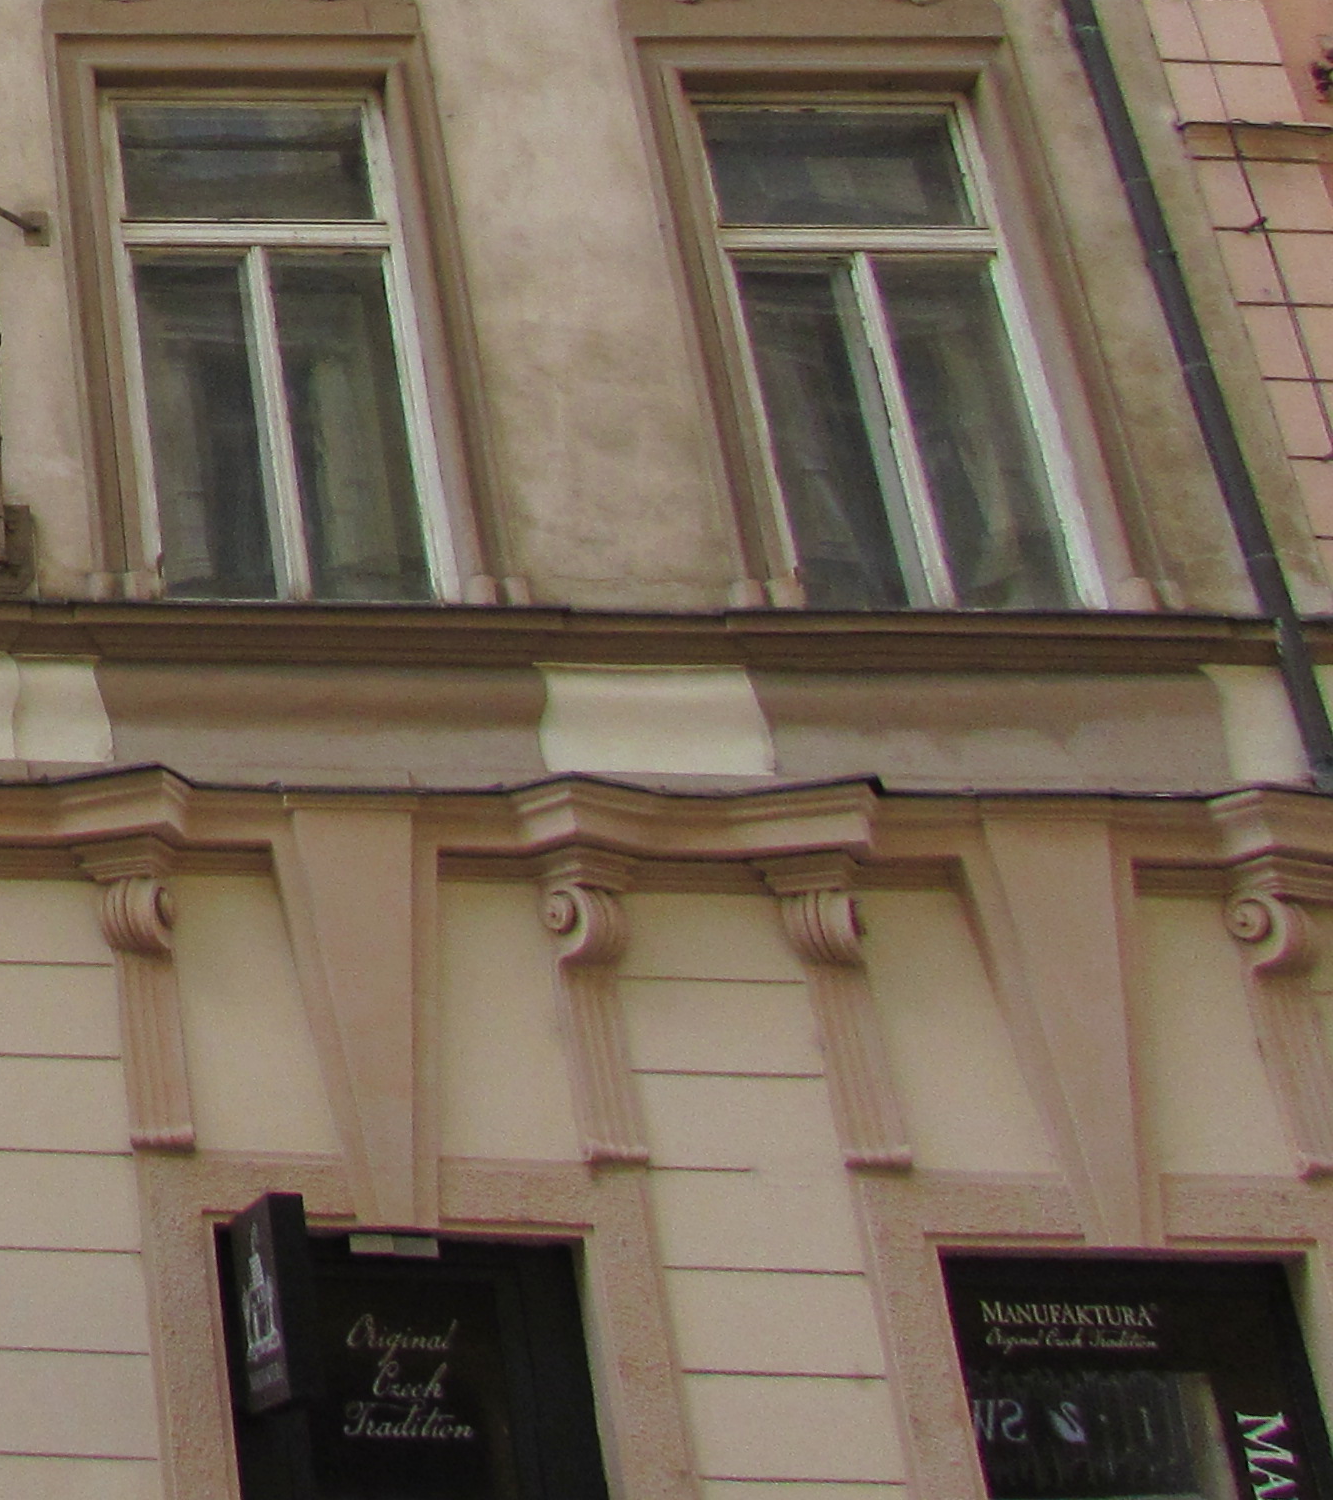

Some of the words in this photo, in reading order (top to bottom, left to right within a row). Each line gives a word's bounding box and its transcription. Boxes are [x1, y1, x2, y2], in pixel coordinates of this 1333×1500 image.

[979, 1299, 1155, 1328] MANUFAKTURA
[345, 1312, 458, 1367] Original
[372, 1360, 448, 1398] Czech
[343, 1399, 475, 1439] Tradition
